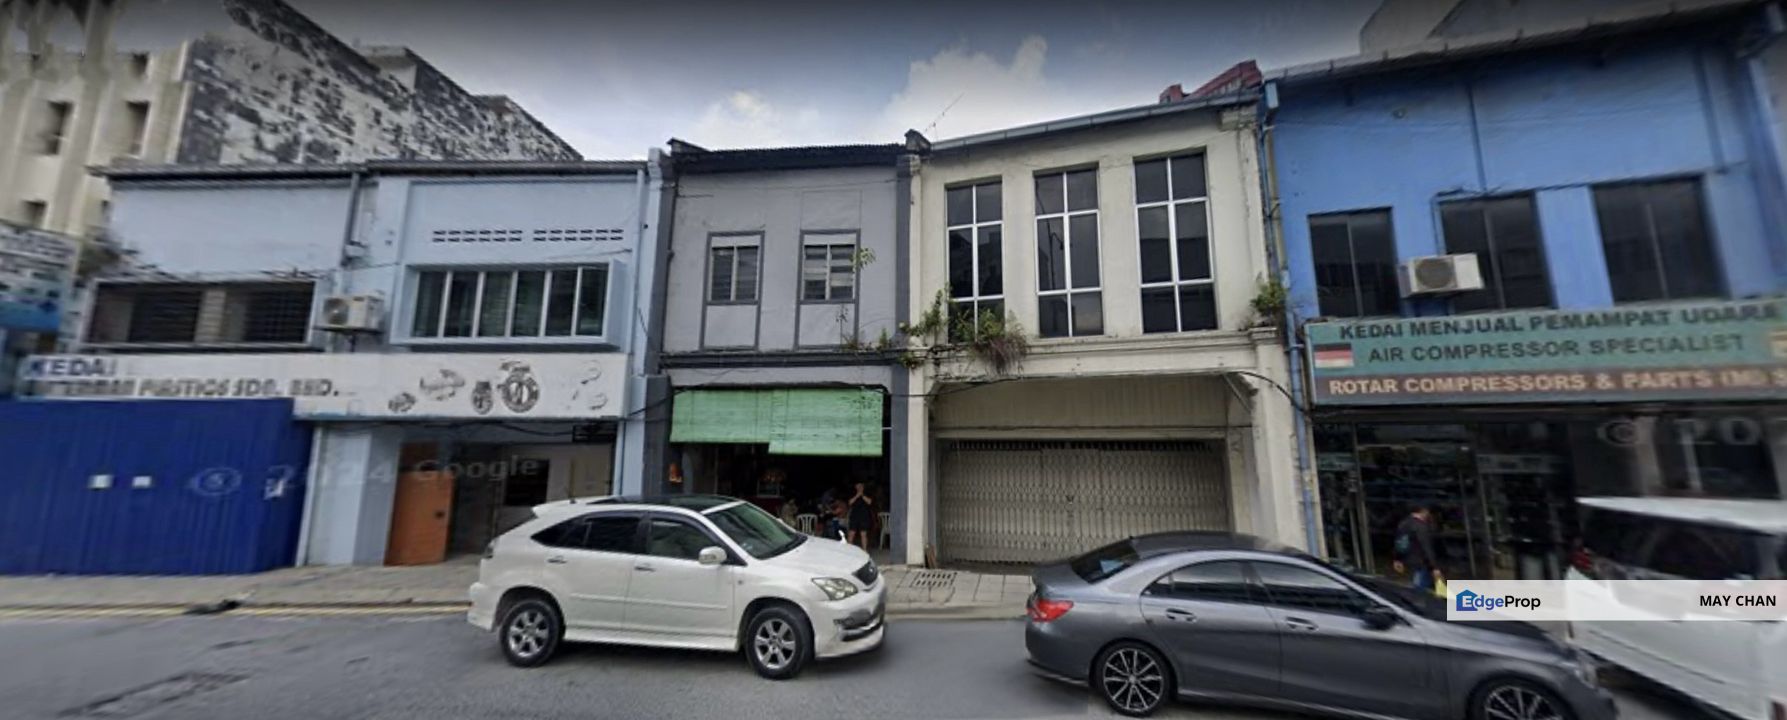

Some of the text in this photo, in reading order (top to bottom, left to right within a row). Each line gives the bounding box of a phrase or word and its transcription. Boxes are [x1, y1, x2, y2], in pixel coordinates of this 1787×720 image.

[1339, 323, 1403, 340] KEDAI
[1410, 316, 1524, 337] MENJUAL
[1530, 309, 1671, 332] PEMAMPAT
[1369, 333, 1743, 363] AIR COMPRESSOR SPECIALIST
[1329, 378, 1399, 395] ROTAR
[1405, 373, 1587, 393] COMPRESSORS
[1595, 373, 1616, 390] &
[1622, 369, 1713, 390] PARTS
